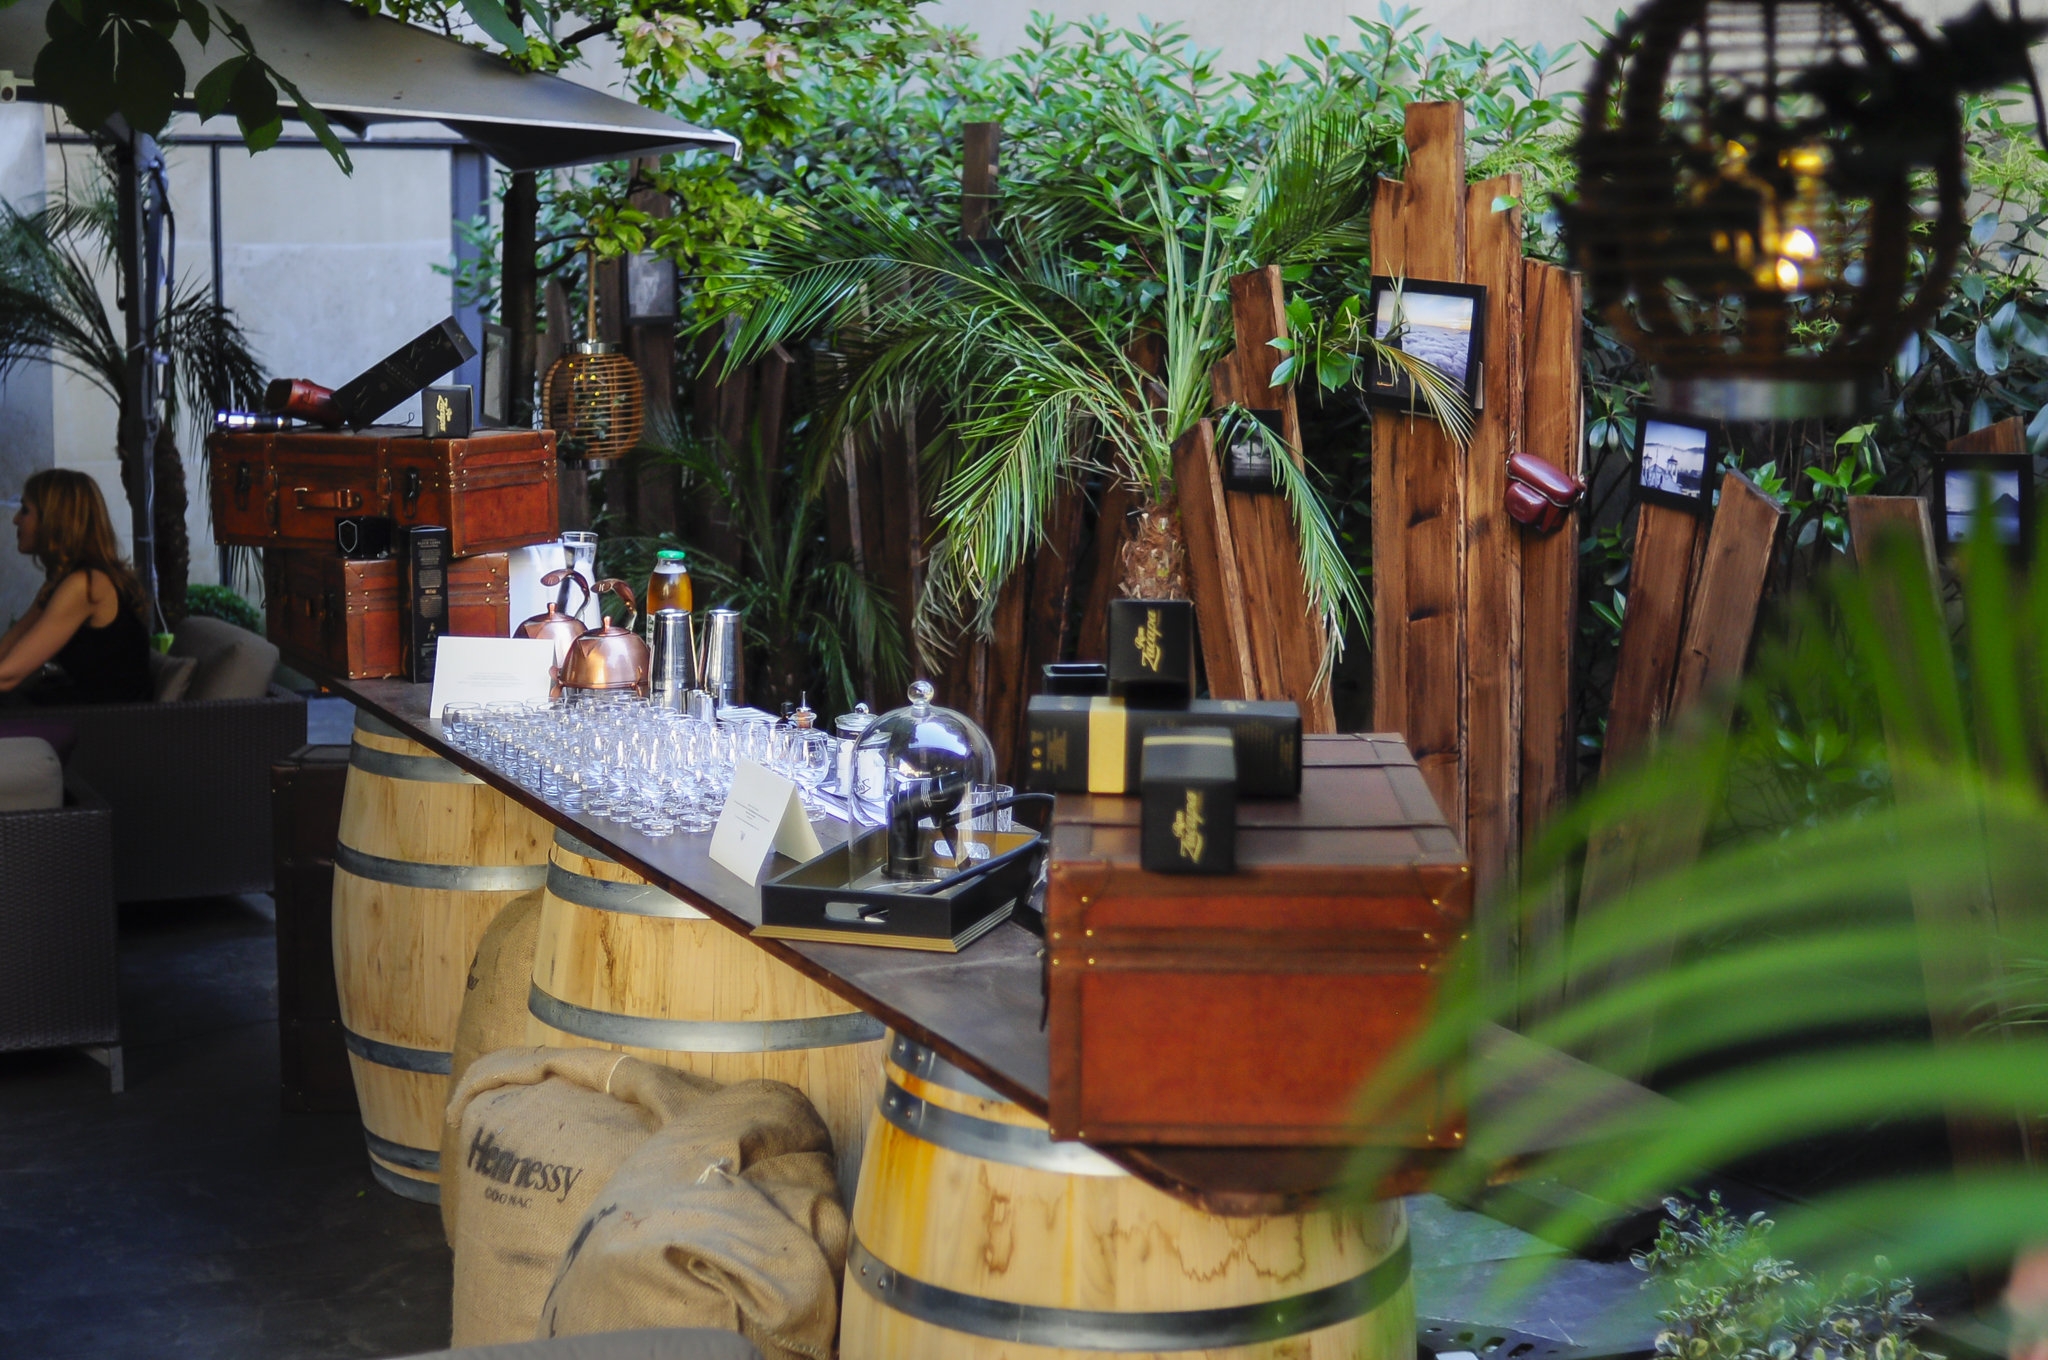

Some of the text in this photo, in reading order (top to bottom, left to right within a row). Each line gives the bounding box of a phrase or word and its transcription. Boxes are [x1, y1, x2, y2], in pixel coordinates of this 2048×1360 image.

[1142, 609, 1162, 672] Zacapa
[1181, 789, 1205, 865] Zacapa
[467, 1126, 583, 1204] Hennessy
